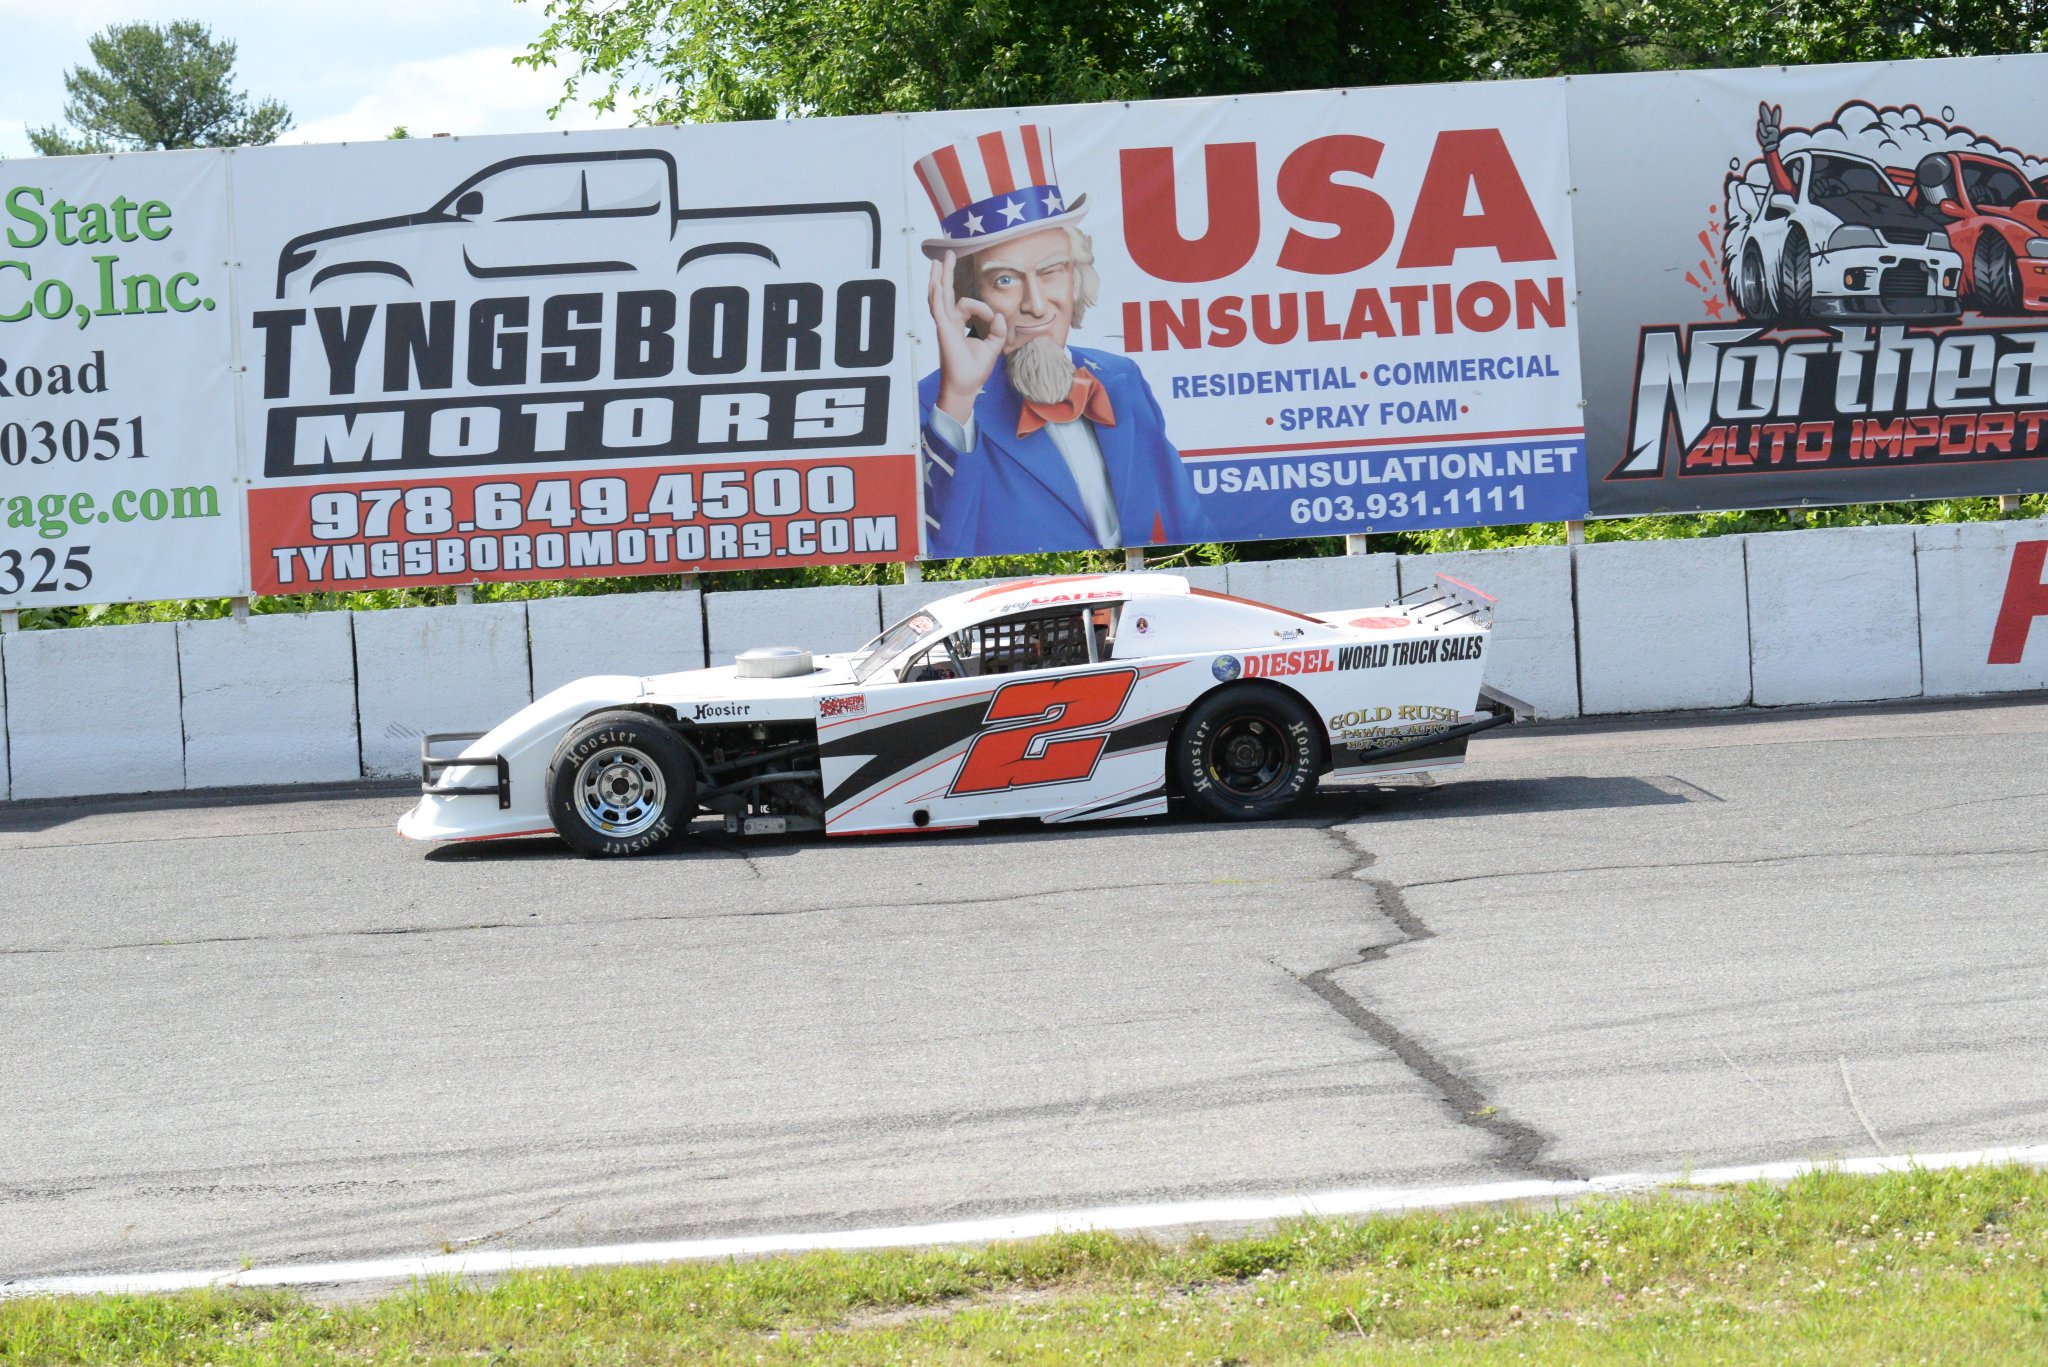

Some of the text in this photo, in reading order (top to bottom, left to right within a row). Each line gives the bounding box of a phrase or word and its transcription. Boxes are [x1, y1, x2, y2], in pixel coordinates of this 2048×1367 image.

[5, 186, 173, 248] State
[1119, 128, 1557, 283] USA
[253, 278, 896, 399] TYNGSBORO
[1122, 277, 1566, 352] INSULATION
[1172, 354, 1559, 399] RESIDENTIAL COMMERCIAL
[294, 387, 866, 466] MOTORS
[1279, 399, 1458, 431] SPRAY FOAM
[0, 416, 149, 466] 03051
[1685, 420, 1834, 468] AUTO
[1193, 447, 1578, 494] USAINSULATION.NET
[0, 485, 221, 539] age.com
[310, 465, 856, 541] 978.649.4500
[1290, 485, 1525, 524] 603.931.1111
[272, 515, 898, 584] TYNGSBOROMOTORS.COM
[1031, 590, 1124, 604] CATES
[1243, 635, 1483, 678] DIESEL WORLD TRUCK SALES
[693, 702, 750, 719] Hoosier
[944, 666, 1140, 799] 2
[1329, 704, 1459, 730] GOLD RUSH
[1340, 726, 1386, 739] PAWN
[1406, 723, 1449, 736] AUTO
[566, 728, 636, 768] Hoosier
[1189, 721, 1212, 792] Hoosier
[1288, 721, 1312, 791] Hoosier
[602, 816, 672, 853] Hoosier
